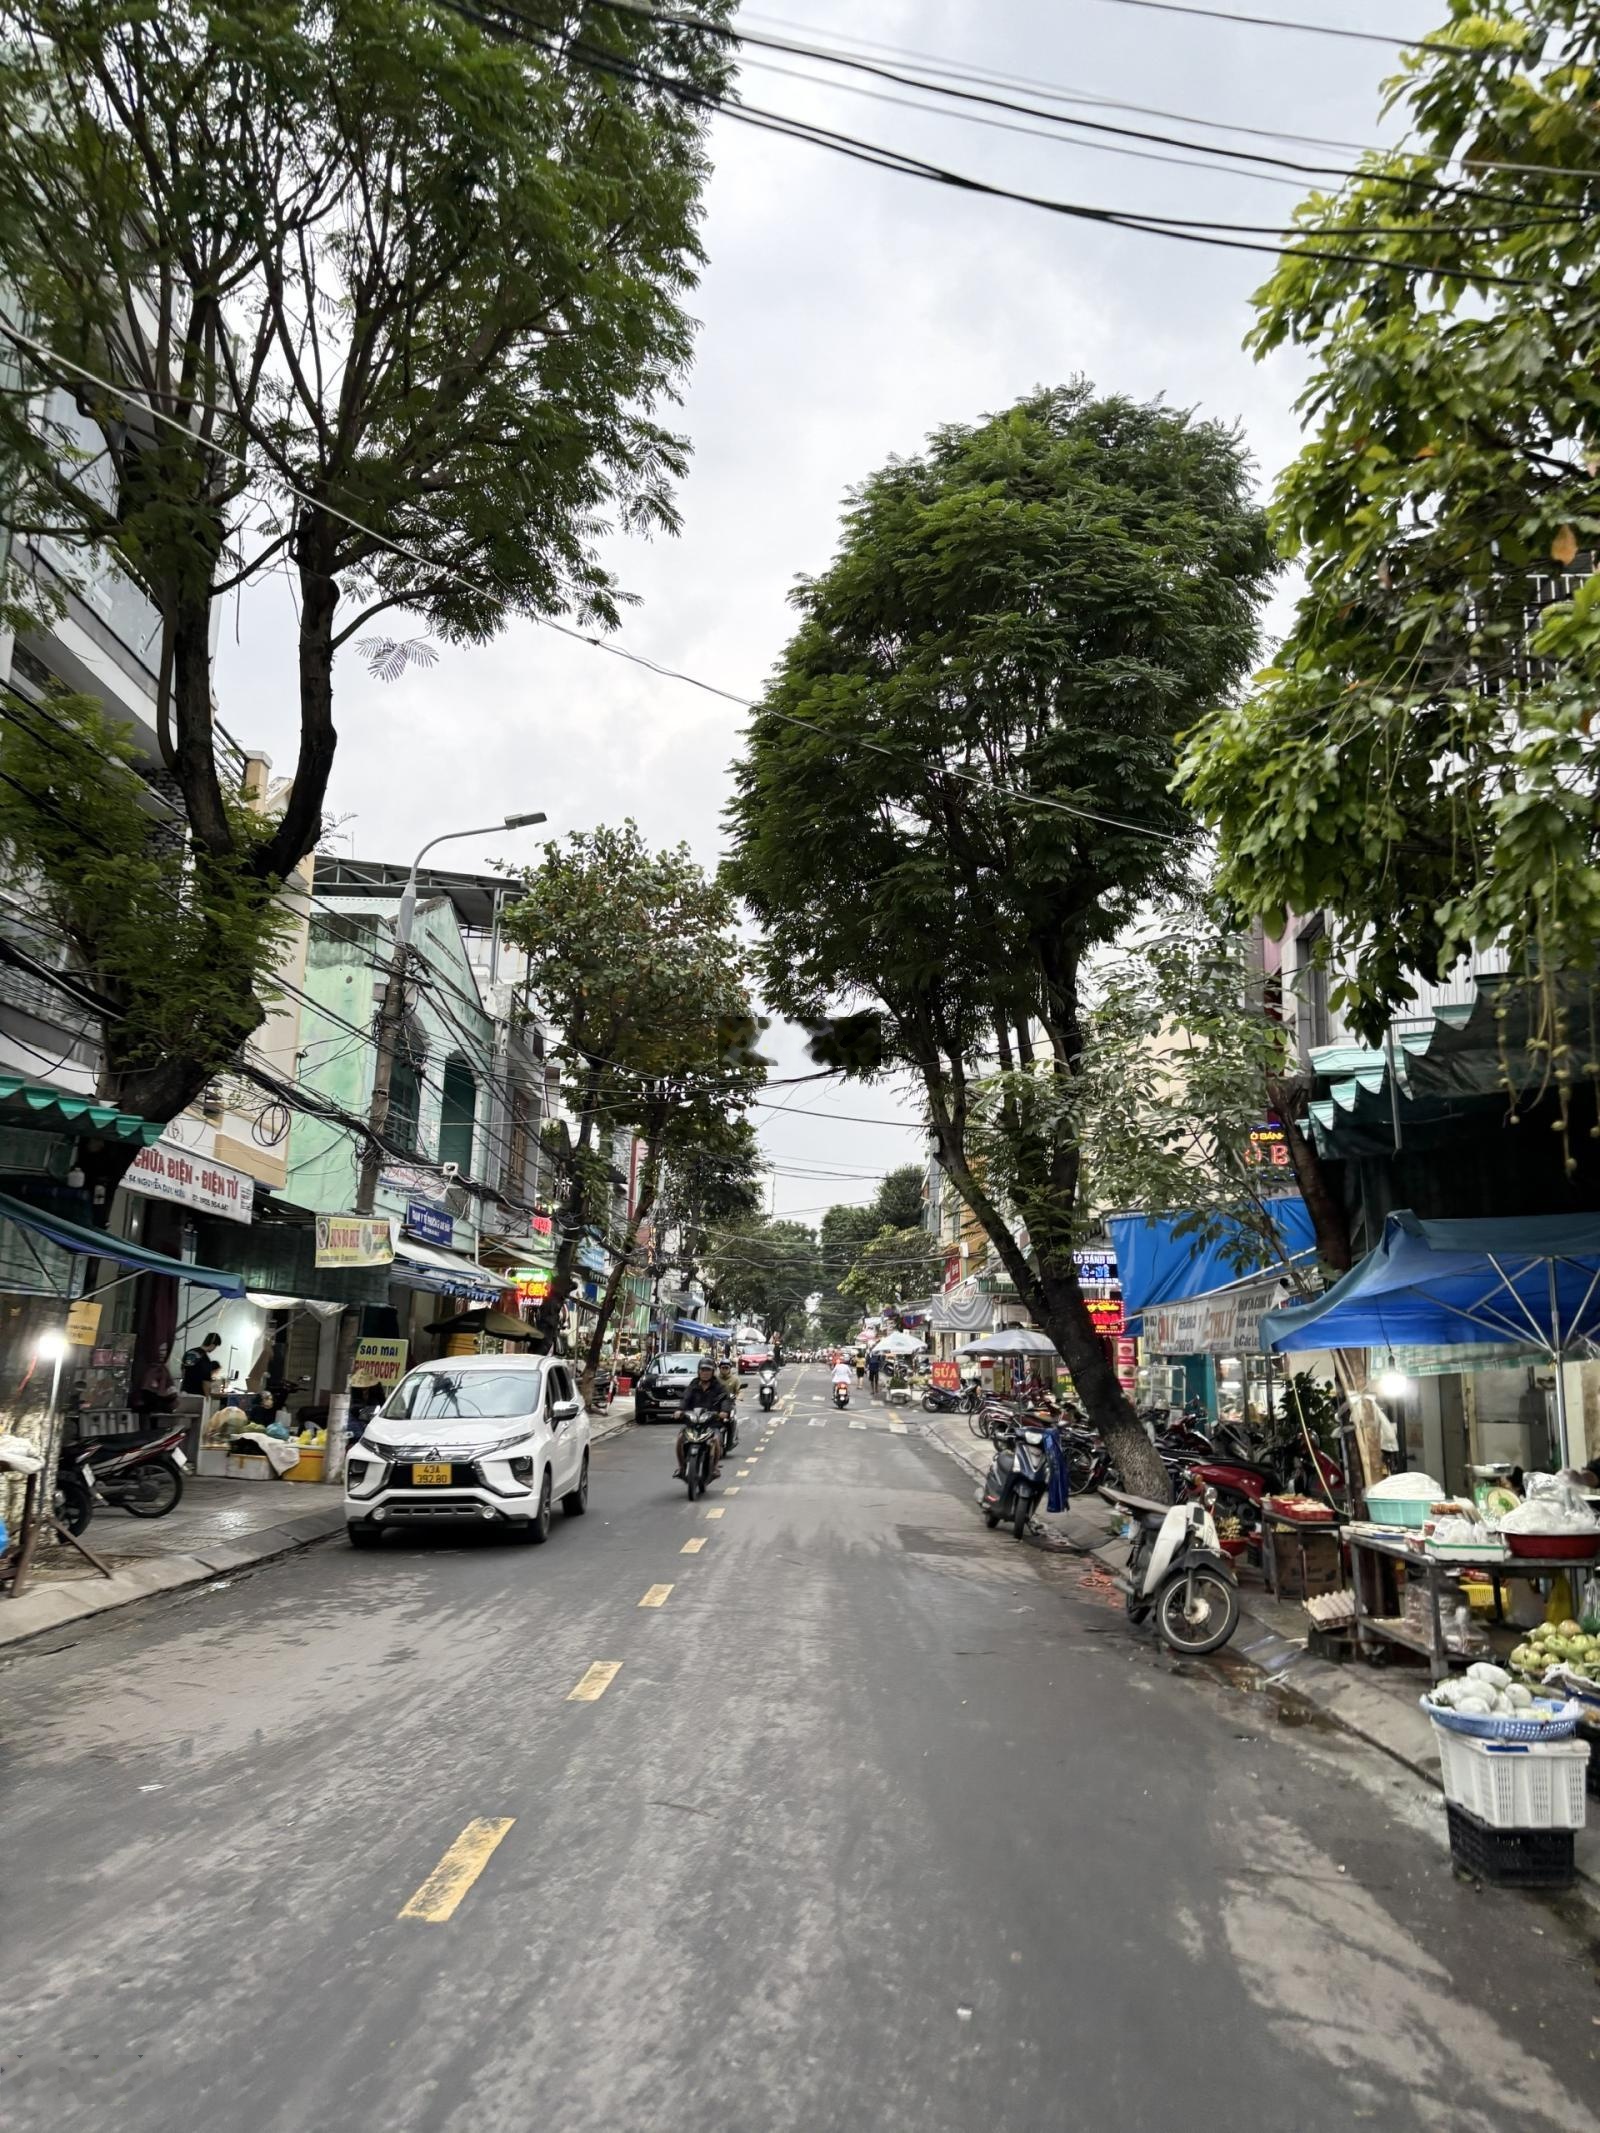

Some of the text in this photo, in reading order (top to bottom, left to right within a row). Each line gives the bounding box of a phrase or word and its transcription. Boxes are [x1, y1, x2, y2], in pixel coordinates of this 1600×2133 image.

[167, 1158, 193, 1186] ĐIỆN
[201, 1170, 225, 1197] ĐIỆN
[226, 1174, 239, 1200] TỬ
[360, 1345, 399, 1356] SAO MAI
[934, 1363, 957, 1379] SỬA
